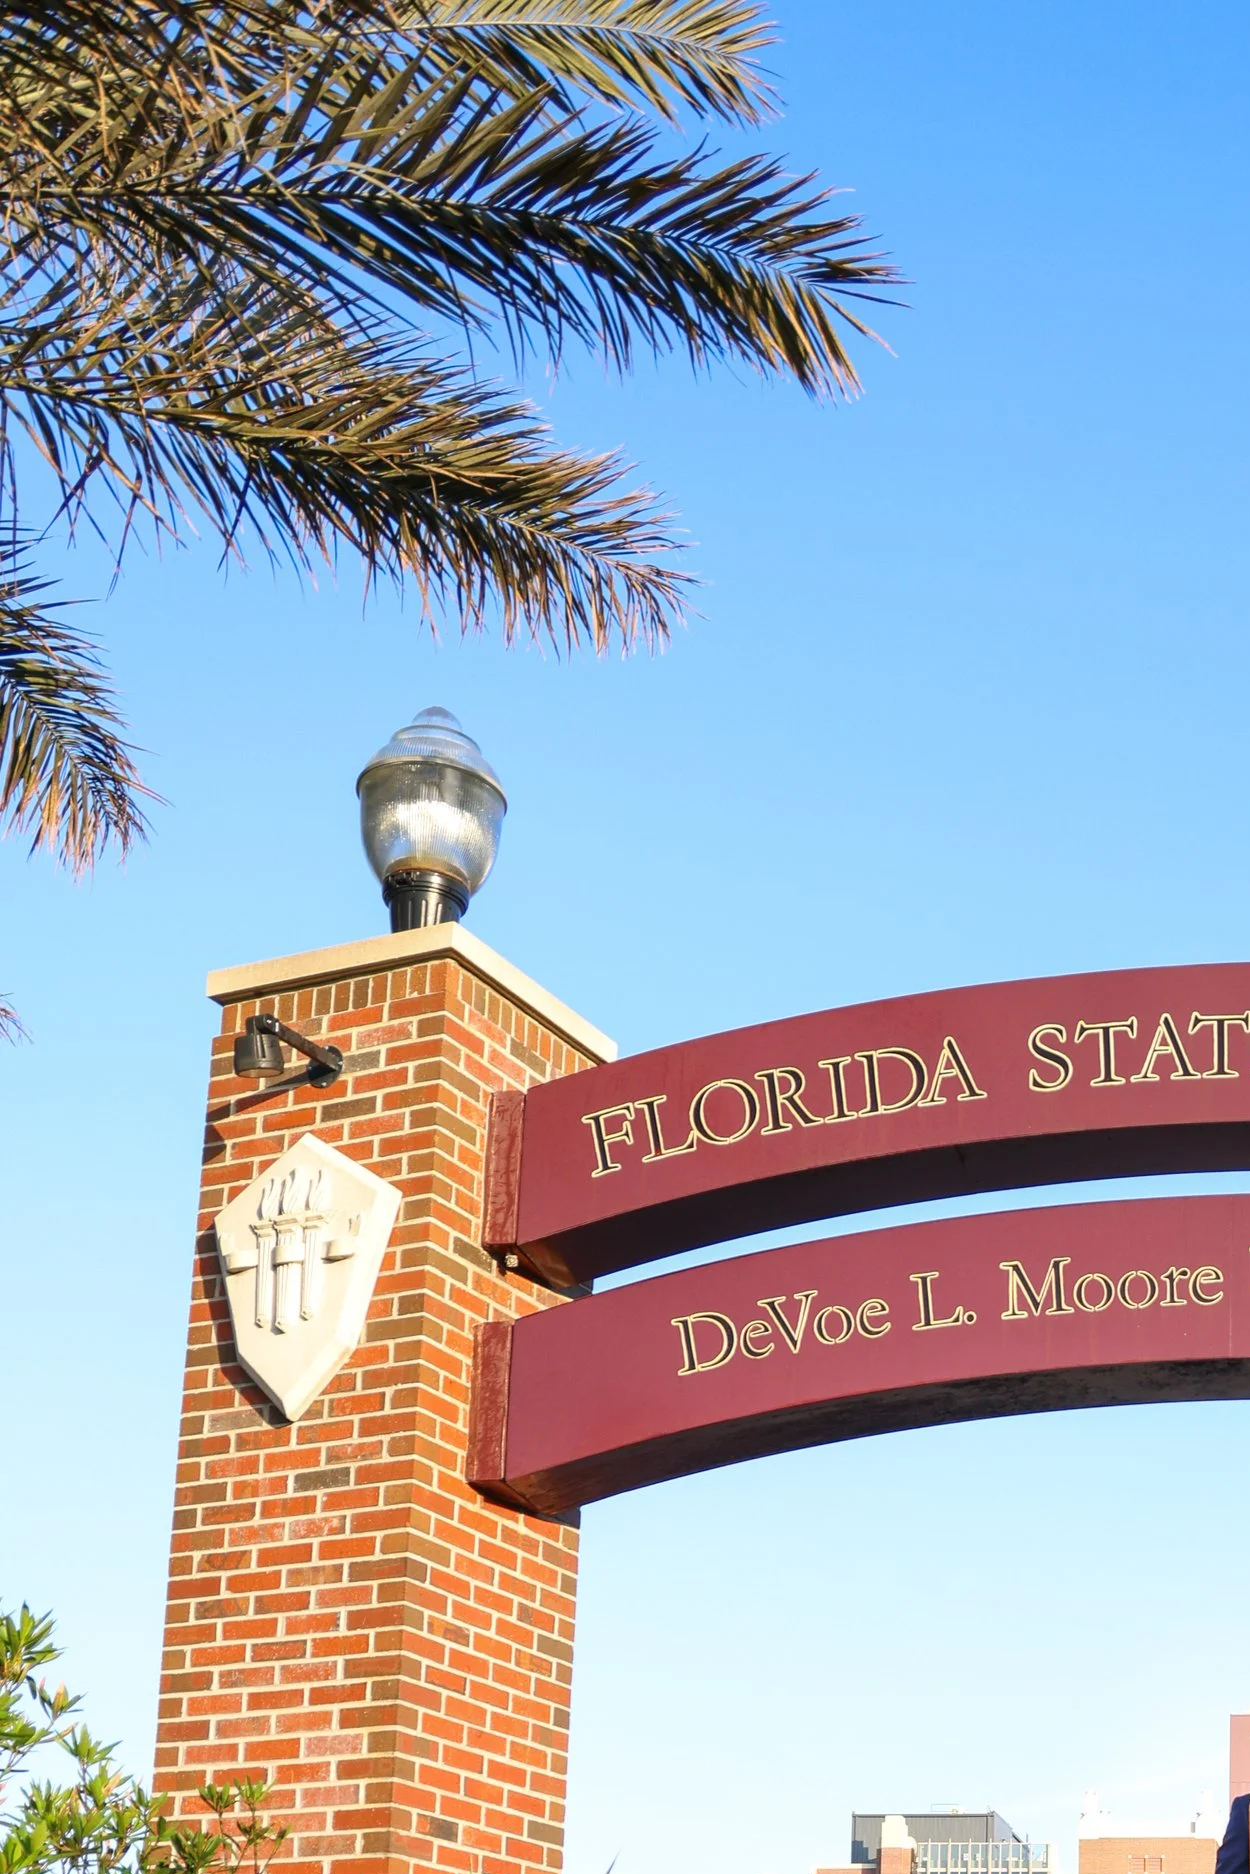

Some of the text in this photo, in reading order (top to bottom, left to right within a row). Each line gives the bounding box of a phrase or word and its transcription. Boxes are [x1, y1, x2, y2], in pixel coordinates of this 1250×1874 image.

[582, 1036, 987, 1178] FLORIDA
[671, 1290, 892, 1377] DeVoe
[910, 1271, 977, 1332] L.
[1000, 1256, 1225, 1321] Moore
